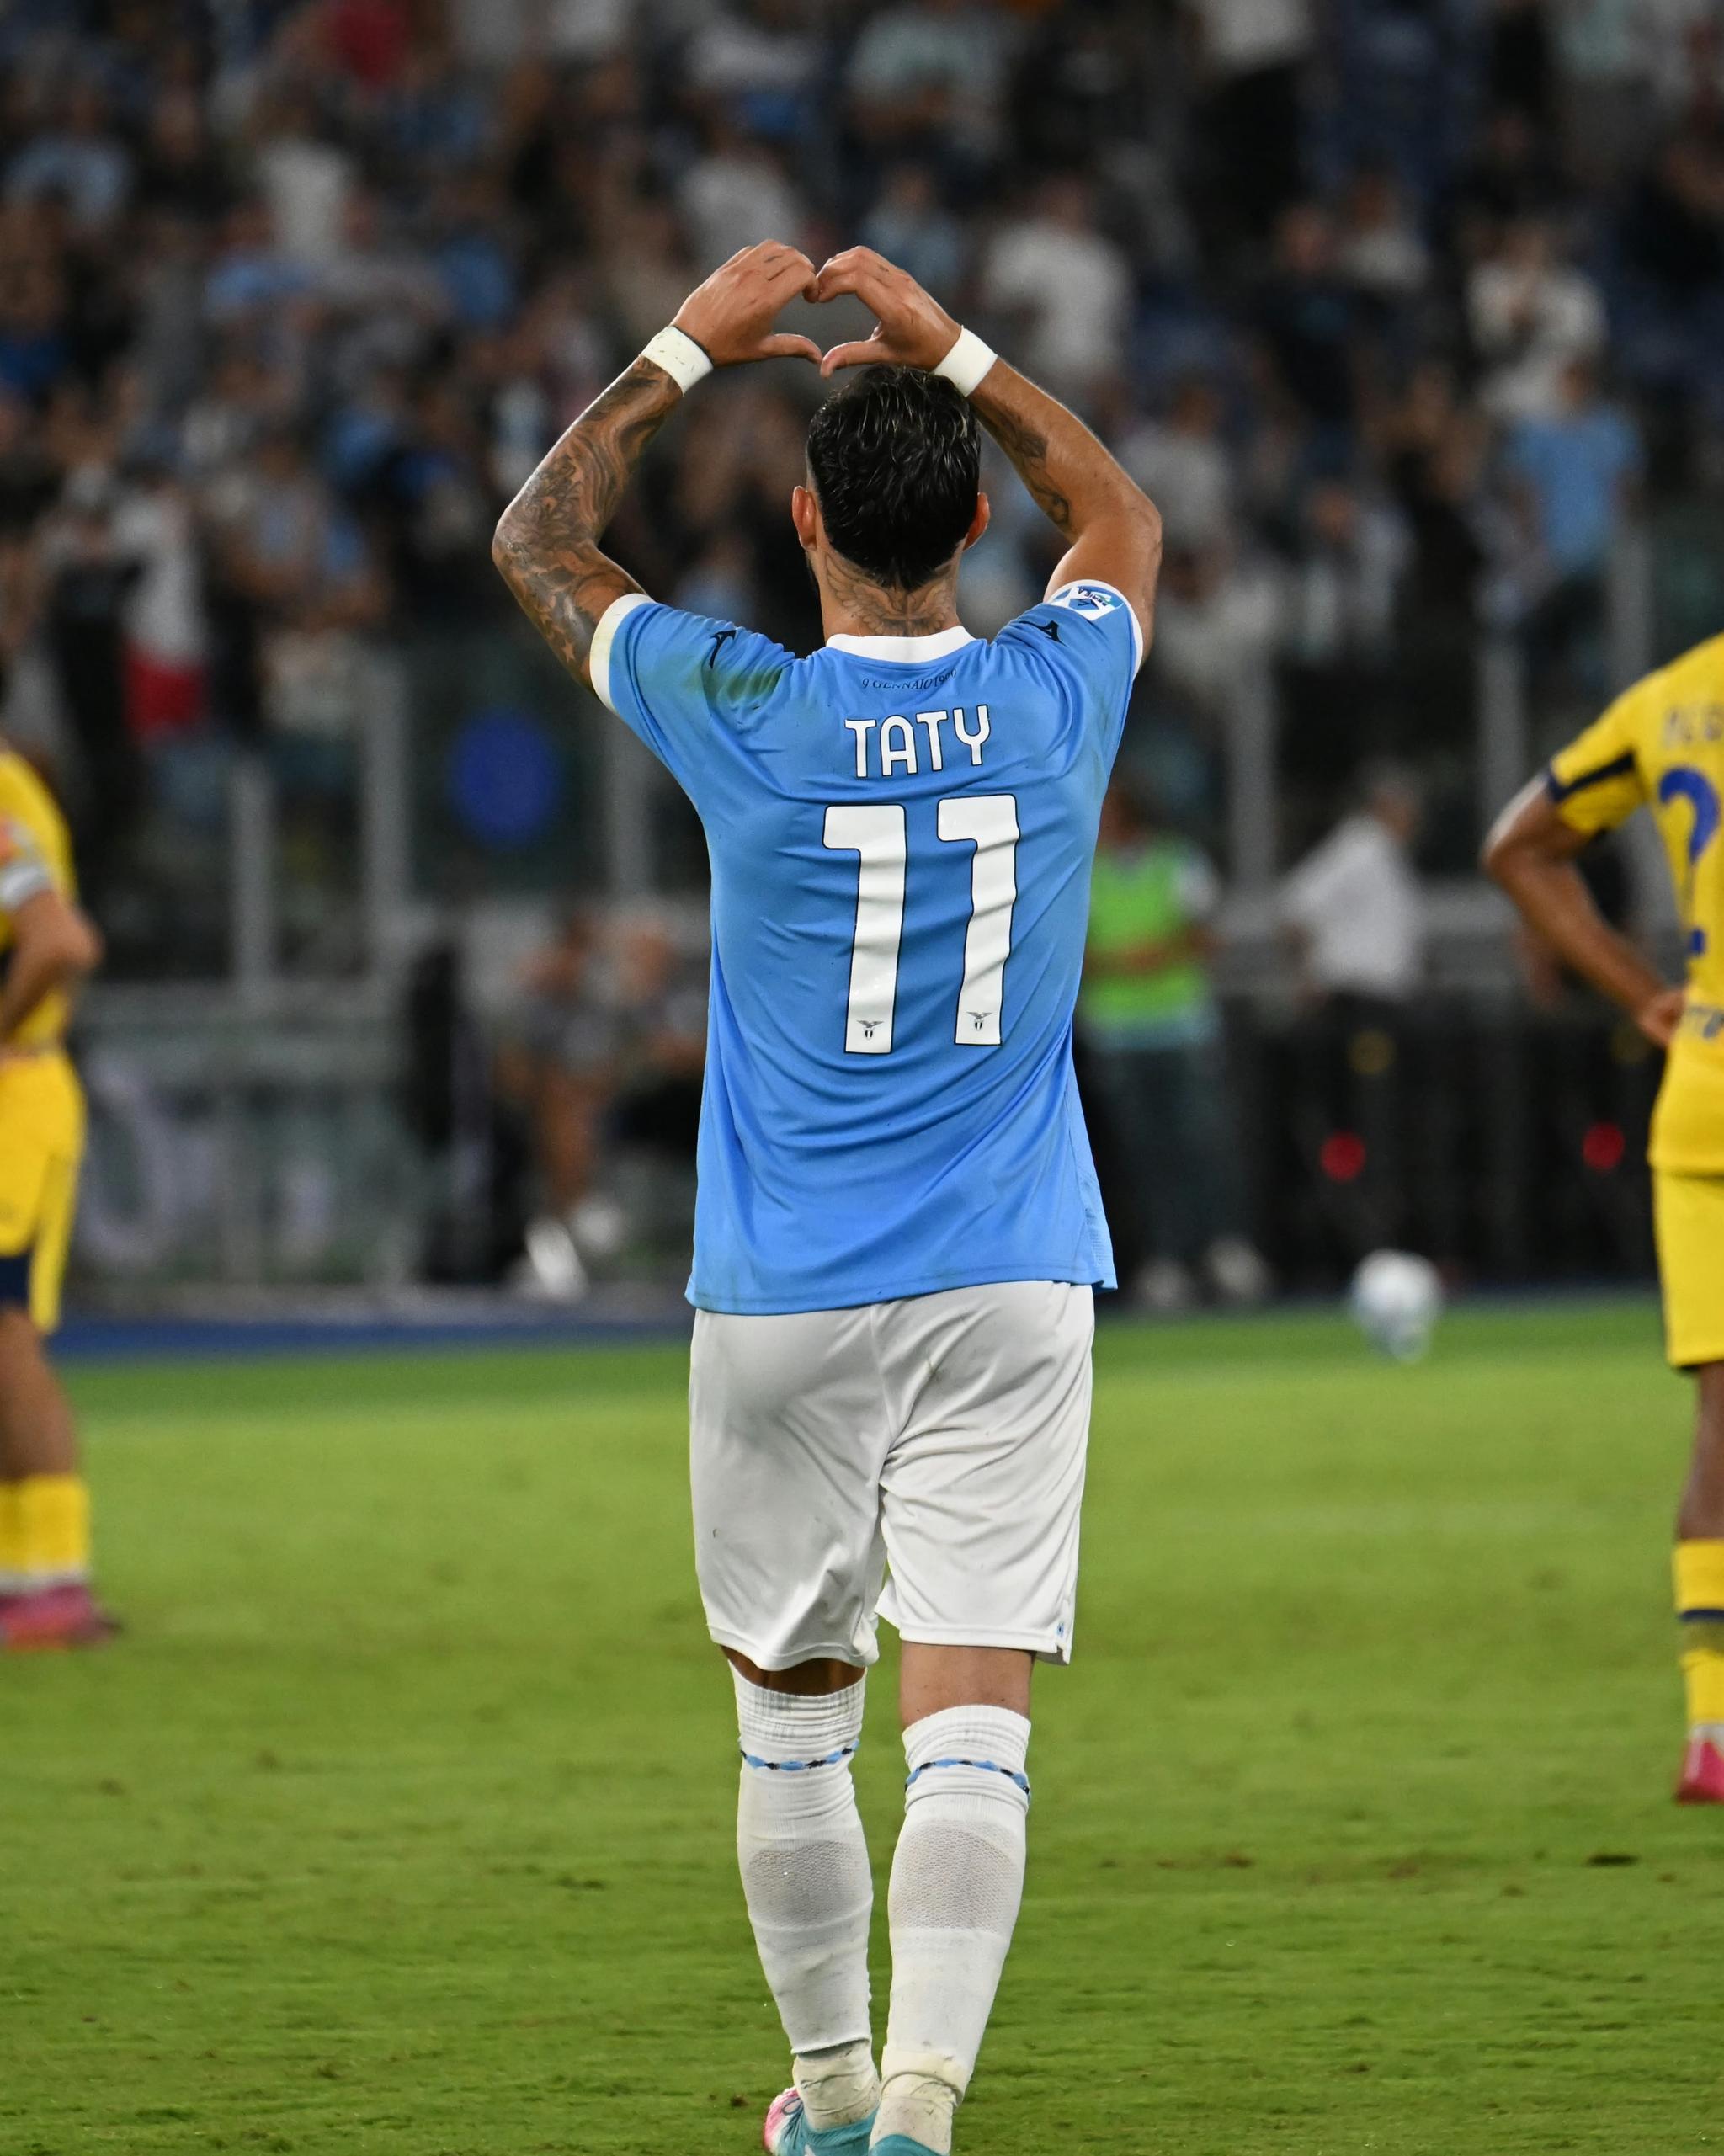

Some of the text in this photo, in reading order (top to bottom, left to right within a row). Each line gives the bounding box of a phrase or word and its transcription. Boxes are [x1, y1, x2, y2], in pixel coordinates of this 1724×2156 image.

[862, 678, 870, 689] 9
[844, 704, 991, 780] TATY
[822, 793, 1020, 1055] 11
